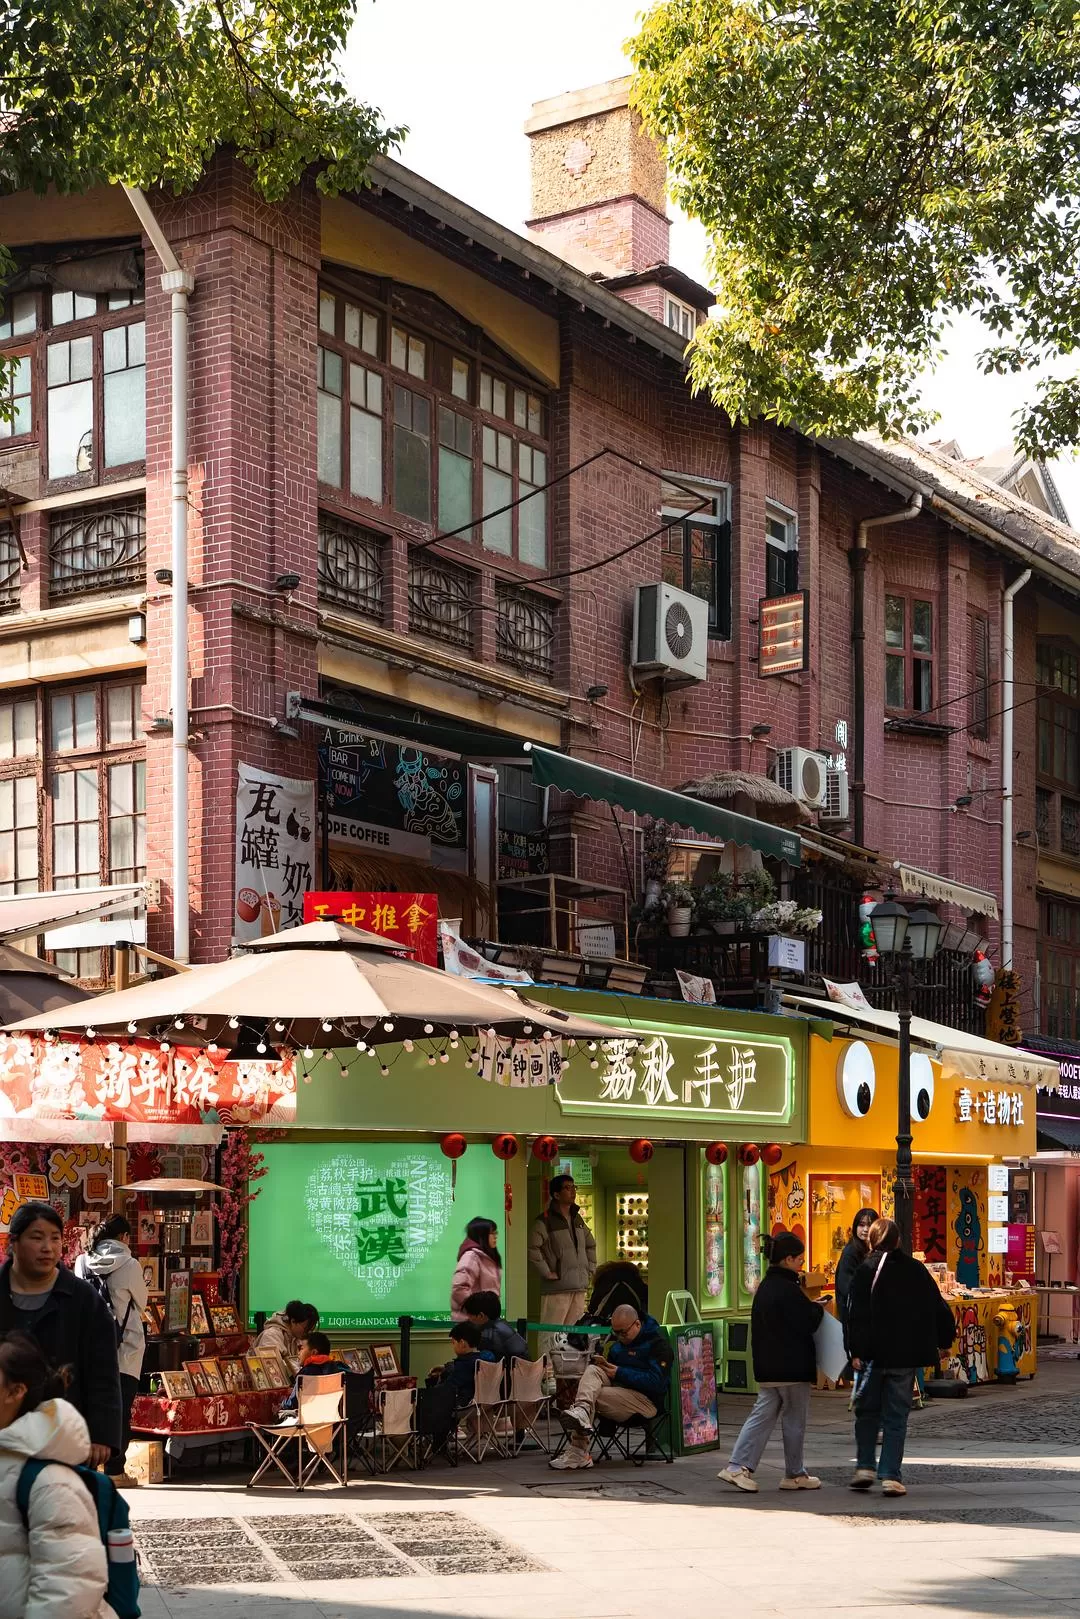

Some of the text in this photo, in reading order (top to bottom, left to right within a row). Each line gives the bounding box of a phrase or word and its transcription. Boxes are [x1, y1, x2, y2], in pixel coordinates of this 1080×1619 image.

[331, 750, 348, 765] BAR
[334, 784, 353, 798] NOW
[241, 778, 283, 869] 瓦罐
[349, 824, 390, 846] COFFEE
[528, 842, 547, 857] BAR
[480, 1046, 563, 1078] 十分钟画像
[599, 1036, 757, 1110] 荔秋手护
[319, 1167, 374, 1182] 荔秋手护
[317, 1182, 354, 1196] 古德寺
[307, 1197, 360, 1211] 黎黄陂路
[409, 1160, 428, 1246] WUHAN
[918, 1166, 946, 1264] 蛇年大
[333, 1213, 352, 1252] 东湖
[335, 1252, 358, 1260] LIQIU
[357, 1266, 401, 1279] LIQIU
